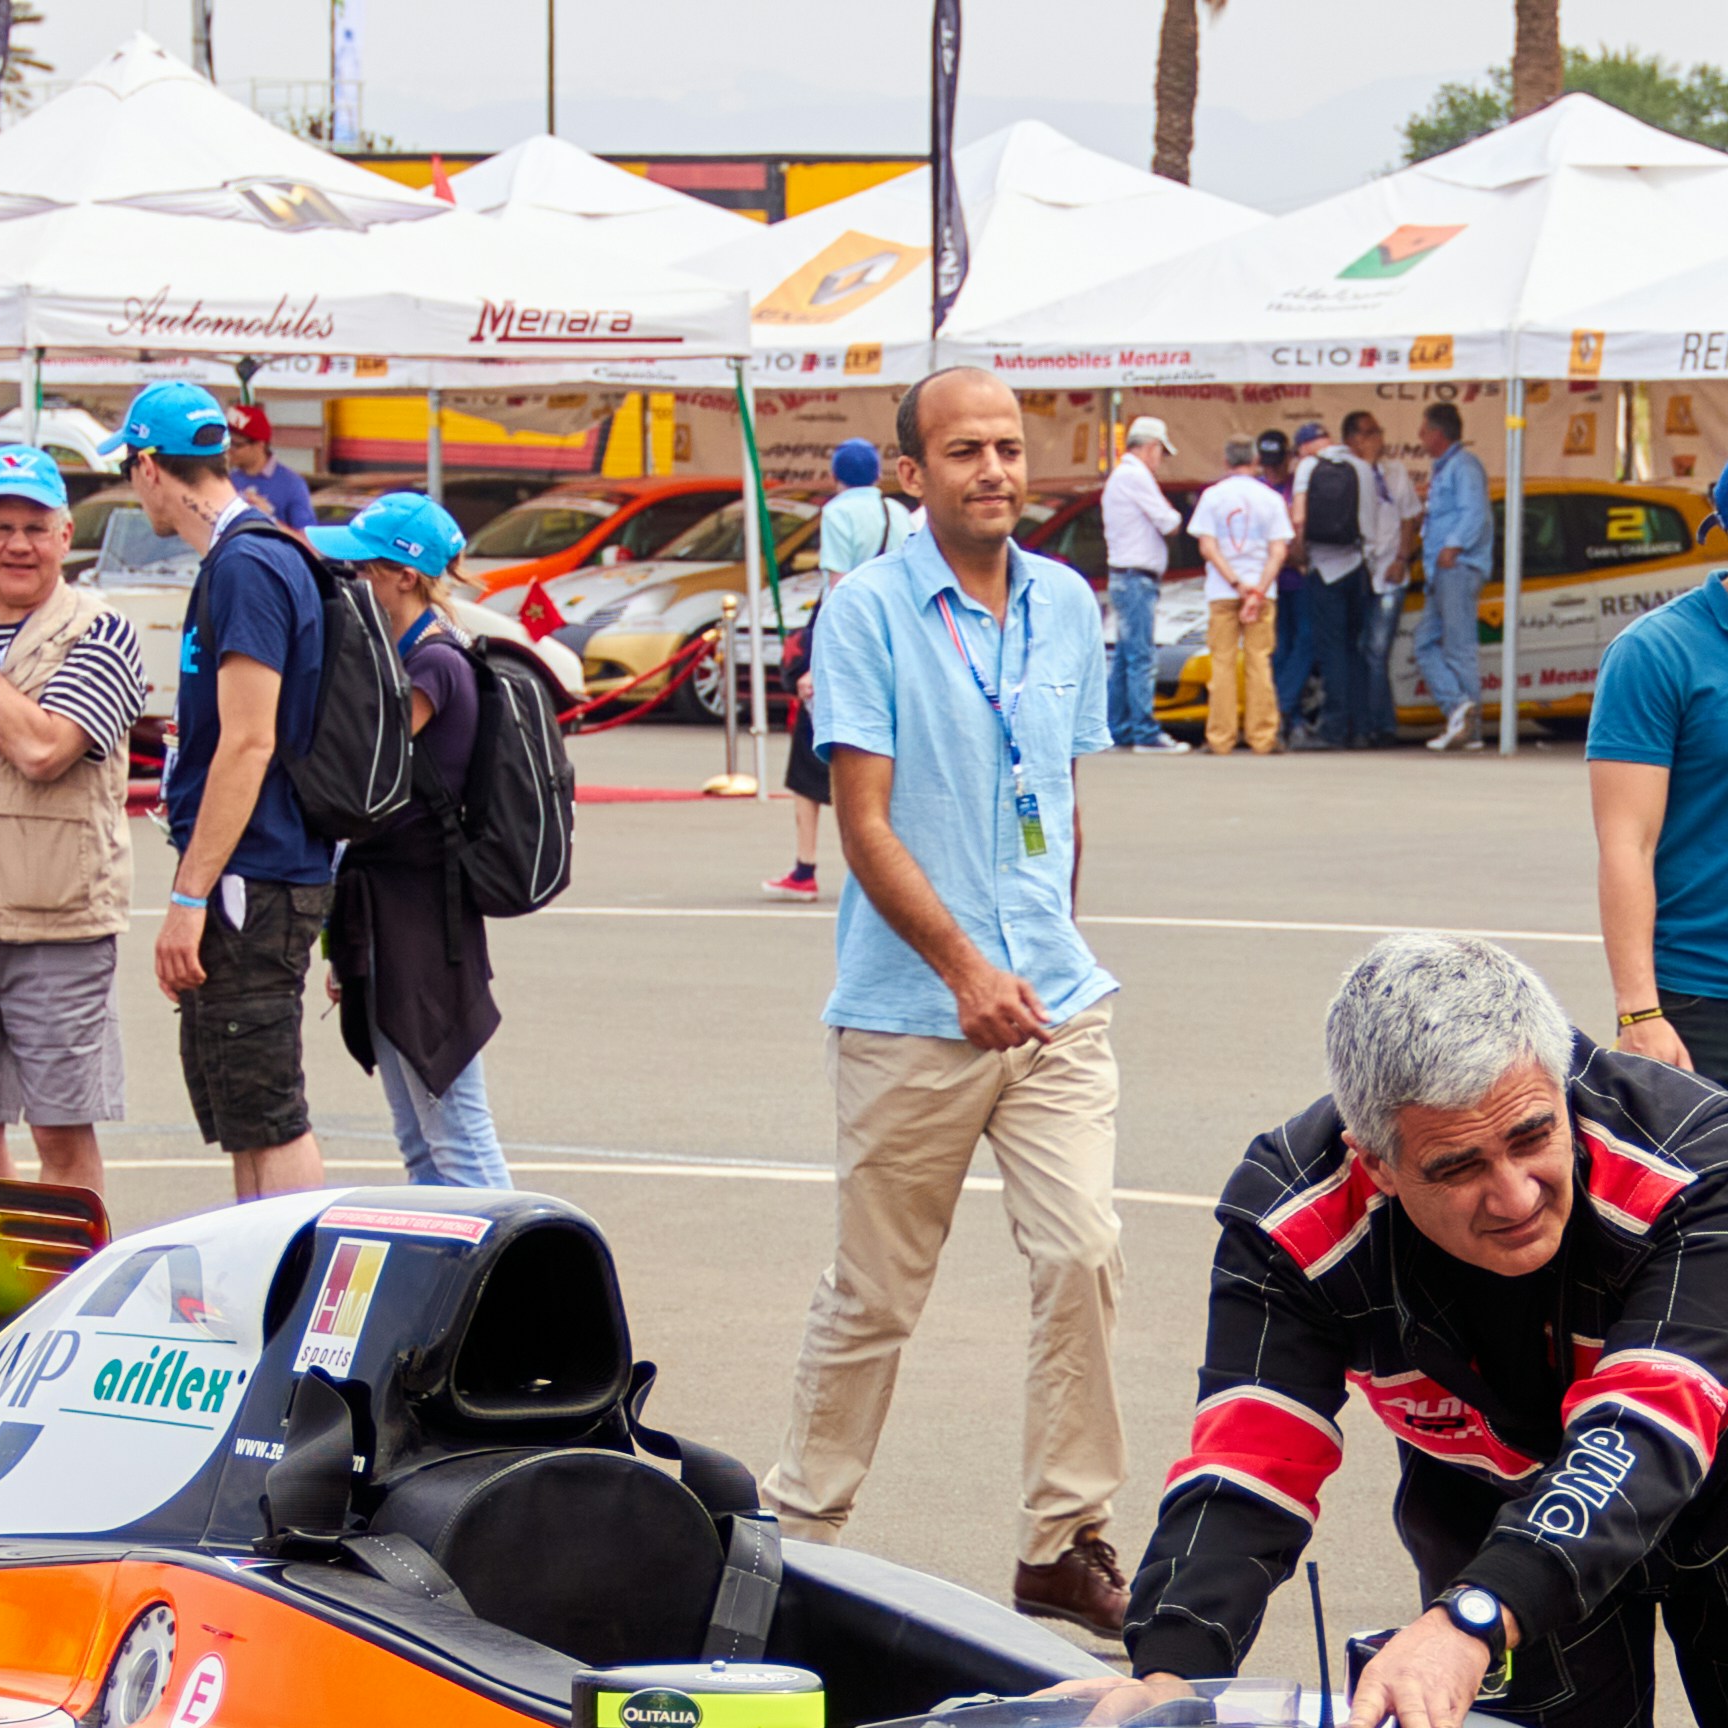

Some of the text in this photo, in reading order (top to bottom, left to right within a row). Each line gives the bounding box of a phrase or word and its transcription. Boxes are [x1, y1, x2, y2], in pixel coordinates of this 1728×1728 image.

[108, 285, 334, 340] Automobiles
[469, 298, 633, 342] Menara
[994, 351, 1191, 369] Automobiles Menara
[1272, 347, 1351, 366] CLIO
[1607, 507, 1645, 540] 2
[315, 1289, 368, 1331] HM
[301, 1345, 351, 1367] sports
[93, 1345, 232, 1413] ariflex
[184, 1671, 215, 1724] E
[624, 1706, 697, 1723] OLITALIA
